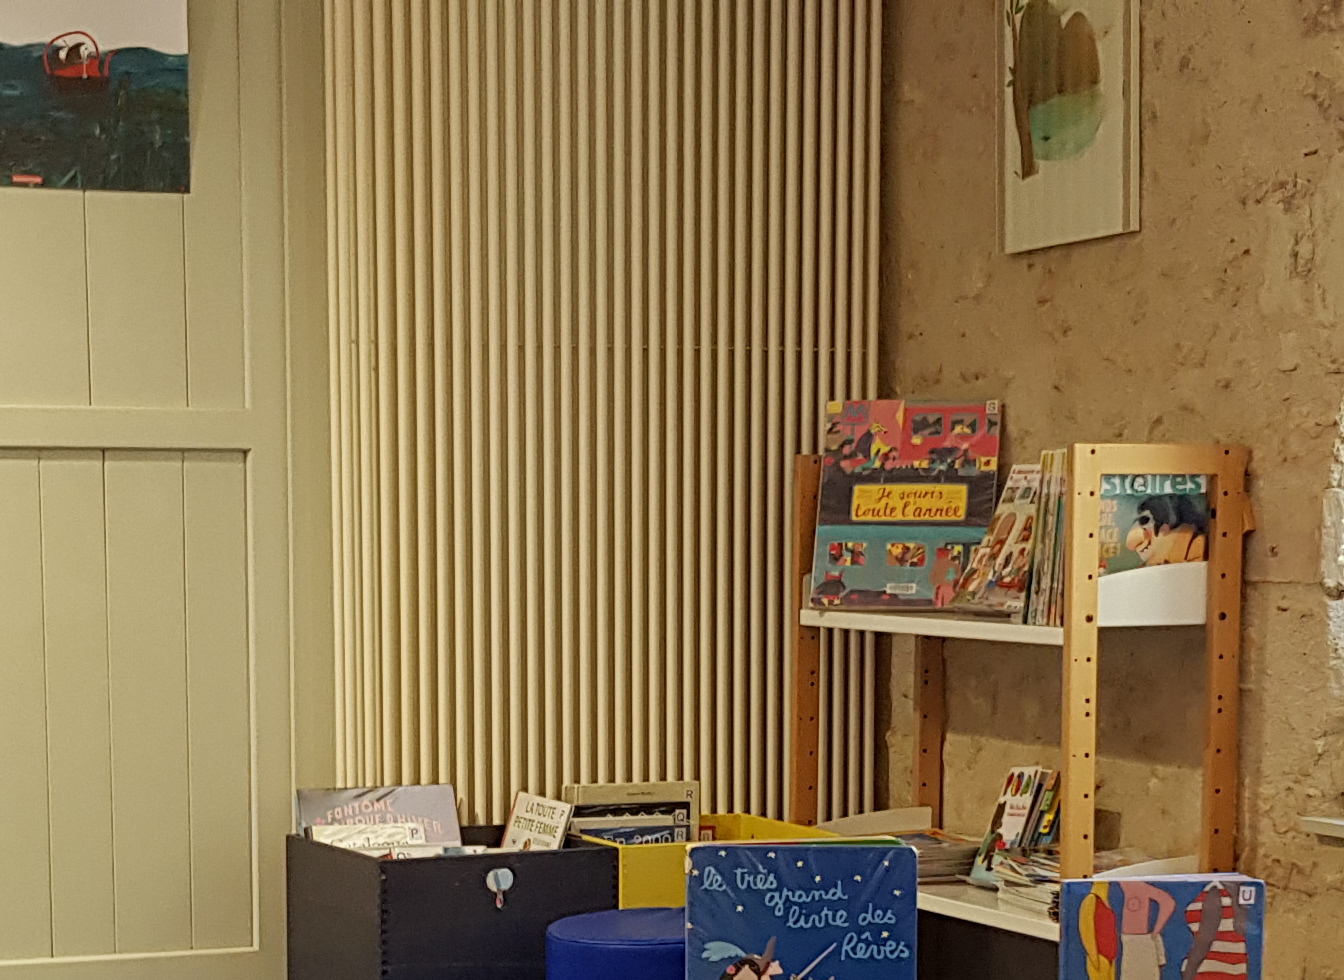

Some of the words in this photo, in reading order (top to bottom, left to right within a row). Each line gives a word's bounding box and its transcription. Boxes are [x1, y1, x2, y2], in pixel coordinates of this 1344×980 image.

[877, 487, 893, 504] Je
[899, 486, 944, 505] souris
[854, 502, 898, 518] toute
[901, 500, 964, 518] l'année
[685, 789, 694, 800] R
[524, 801, 534, 814] LA
[535, 802, 558, 821] TOUTE
[676, 811, 685, 823] Q
[513, 815, 535, 833] PETITE
[535, 819, 560, 839] FEMME
[676, 830, 685, 842] R
[700, 866, 726, 891] le
[734, 864, 778, 889] très
[764, 880, 849, 917] grand
[1242, 889, 1253, 902] U
[786, 904, 850, 929] livre
[858, 902, 897, 926] des
[841, 930, 911, 961] Rêves
